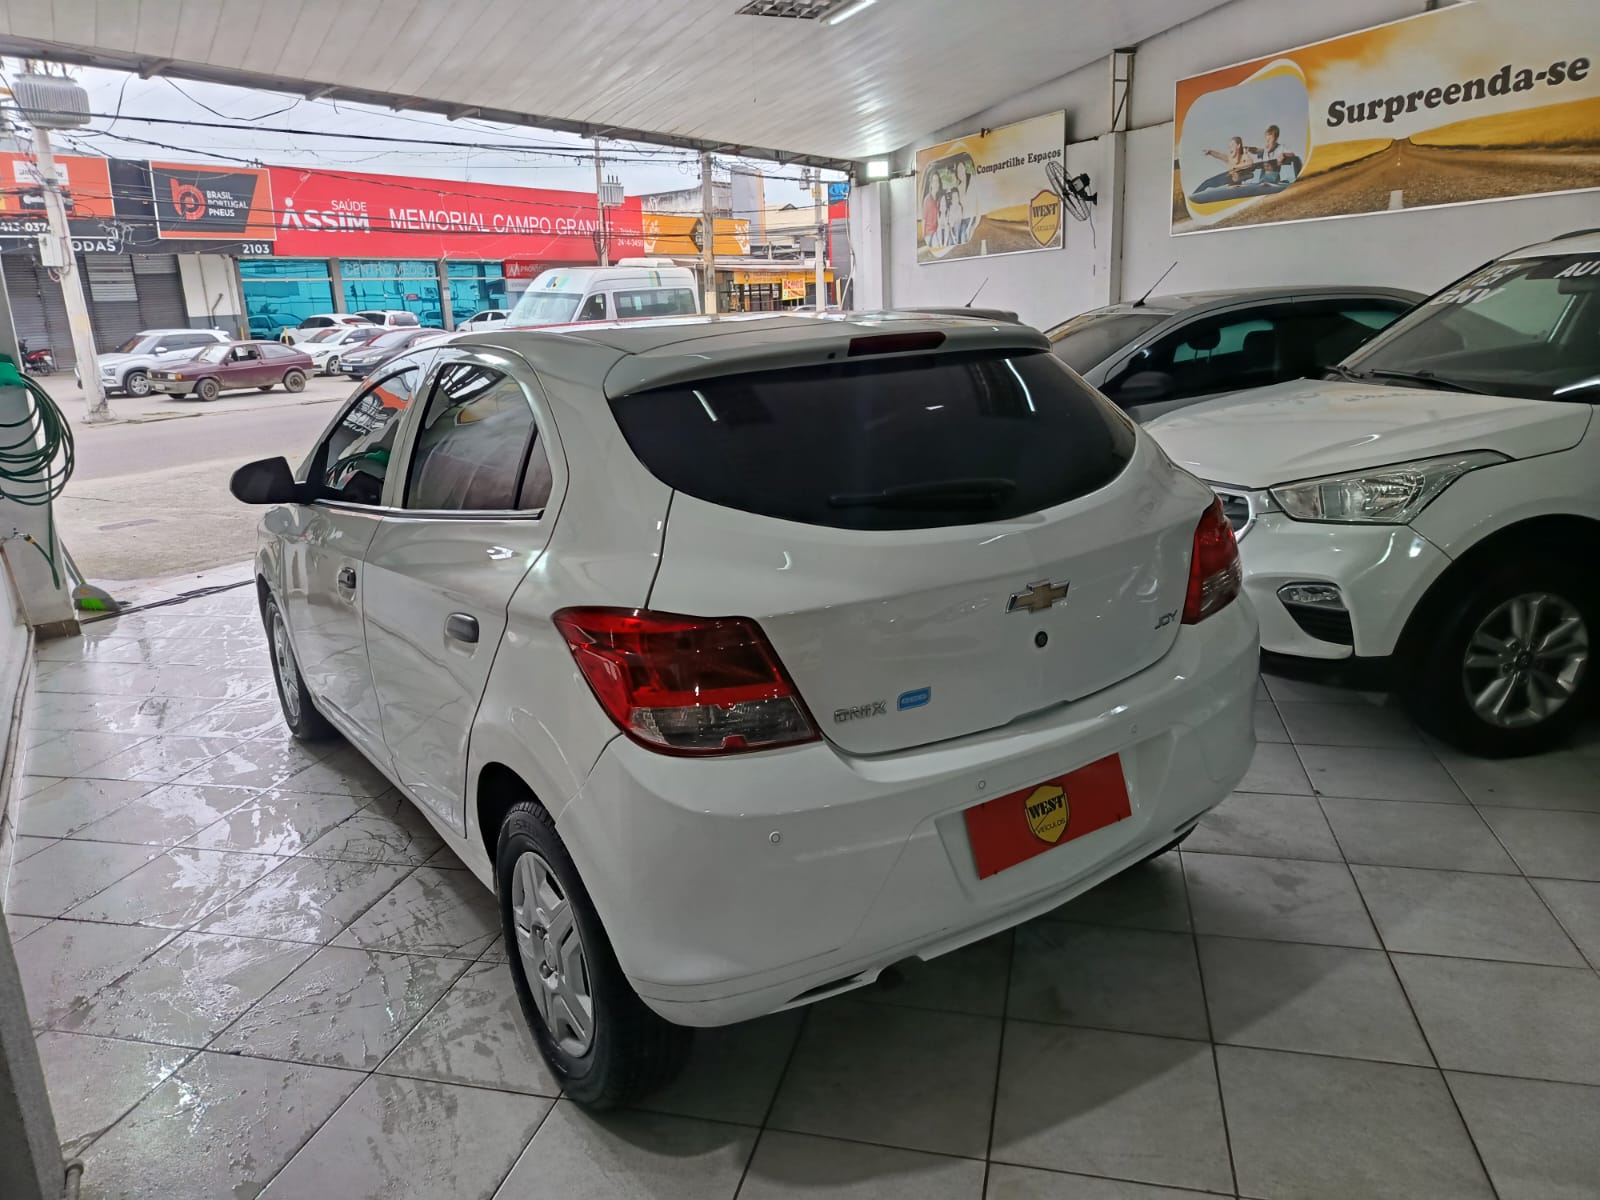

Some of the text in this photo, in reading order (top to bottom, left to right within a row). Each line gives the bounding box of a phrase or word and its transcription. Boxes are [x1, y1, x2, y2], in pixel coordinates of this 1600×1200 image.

[1326, 57, 1591, 127] Surpreenda-se
[976, 149, 1062, 175] Compartilhe Espaços
[206, 190, 233, 200] BRASIL
[207, 200, 249, 209] PORTUGAL
[208, 208, 235, 217] PNEUS
[331, 199, 367, 212] SAÚDE
[1032, 202, 1058, 219] WEST
[280, 198, 370, 233] ASSIM
[389, 208, 490, 233] MEMORIAL
[493, 214, 551, 234] CAMPO
[72, 239, 117, 252] ODAS
[242, 244, 270, 254] 2103
[1430, 287, 1506, 306] GNV
[1154, 609, 1178, 630] JOY
[833, 700, 888, 724] ONIX
[1028, 793, 1064, 819] WEST
